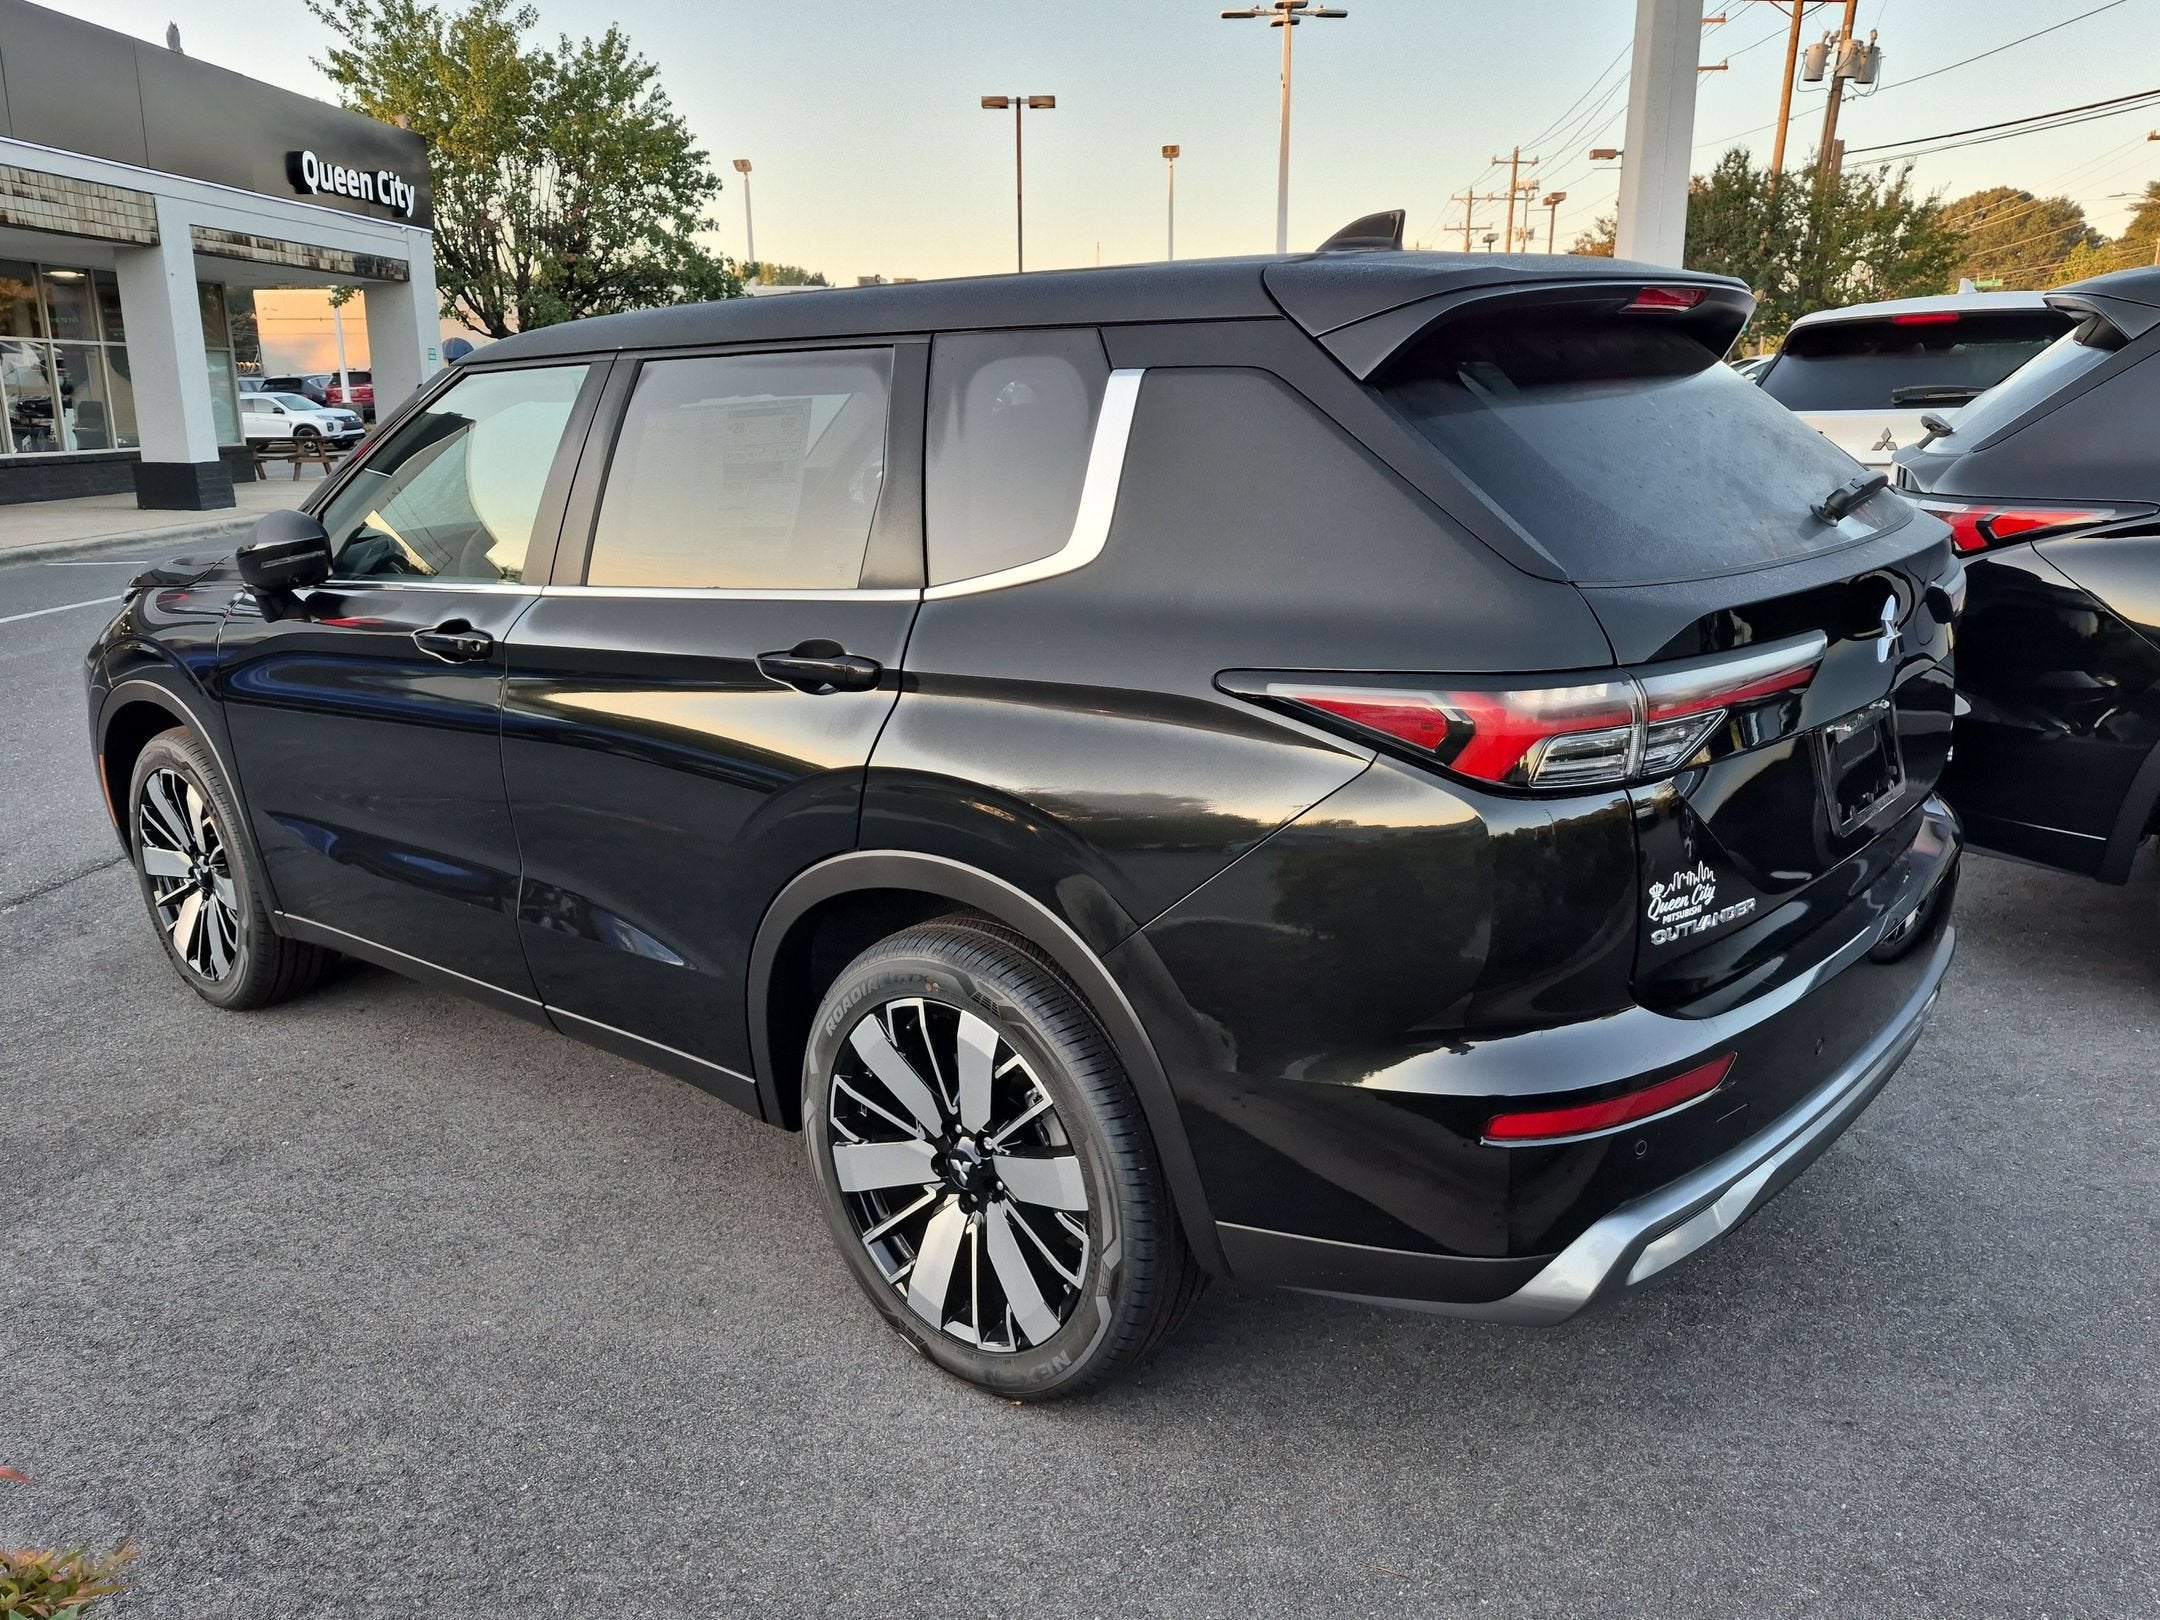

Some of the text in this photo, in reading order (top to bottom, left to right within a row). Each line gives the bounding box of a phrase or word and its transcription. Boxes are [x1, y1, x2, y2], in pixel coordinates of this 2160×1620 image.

[302, 150, 415, 218] Queen City
[1647, 883, 1716, 921] Queen City
[1650, 897, 1757, 946] OUTLANDER
[1662, 904, 1703, 924] MITSUBISHI
